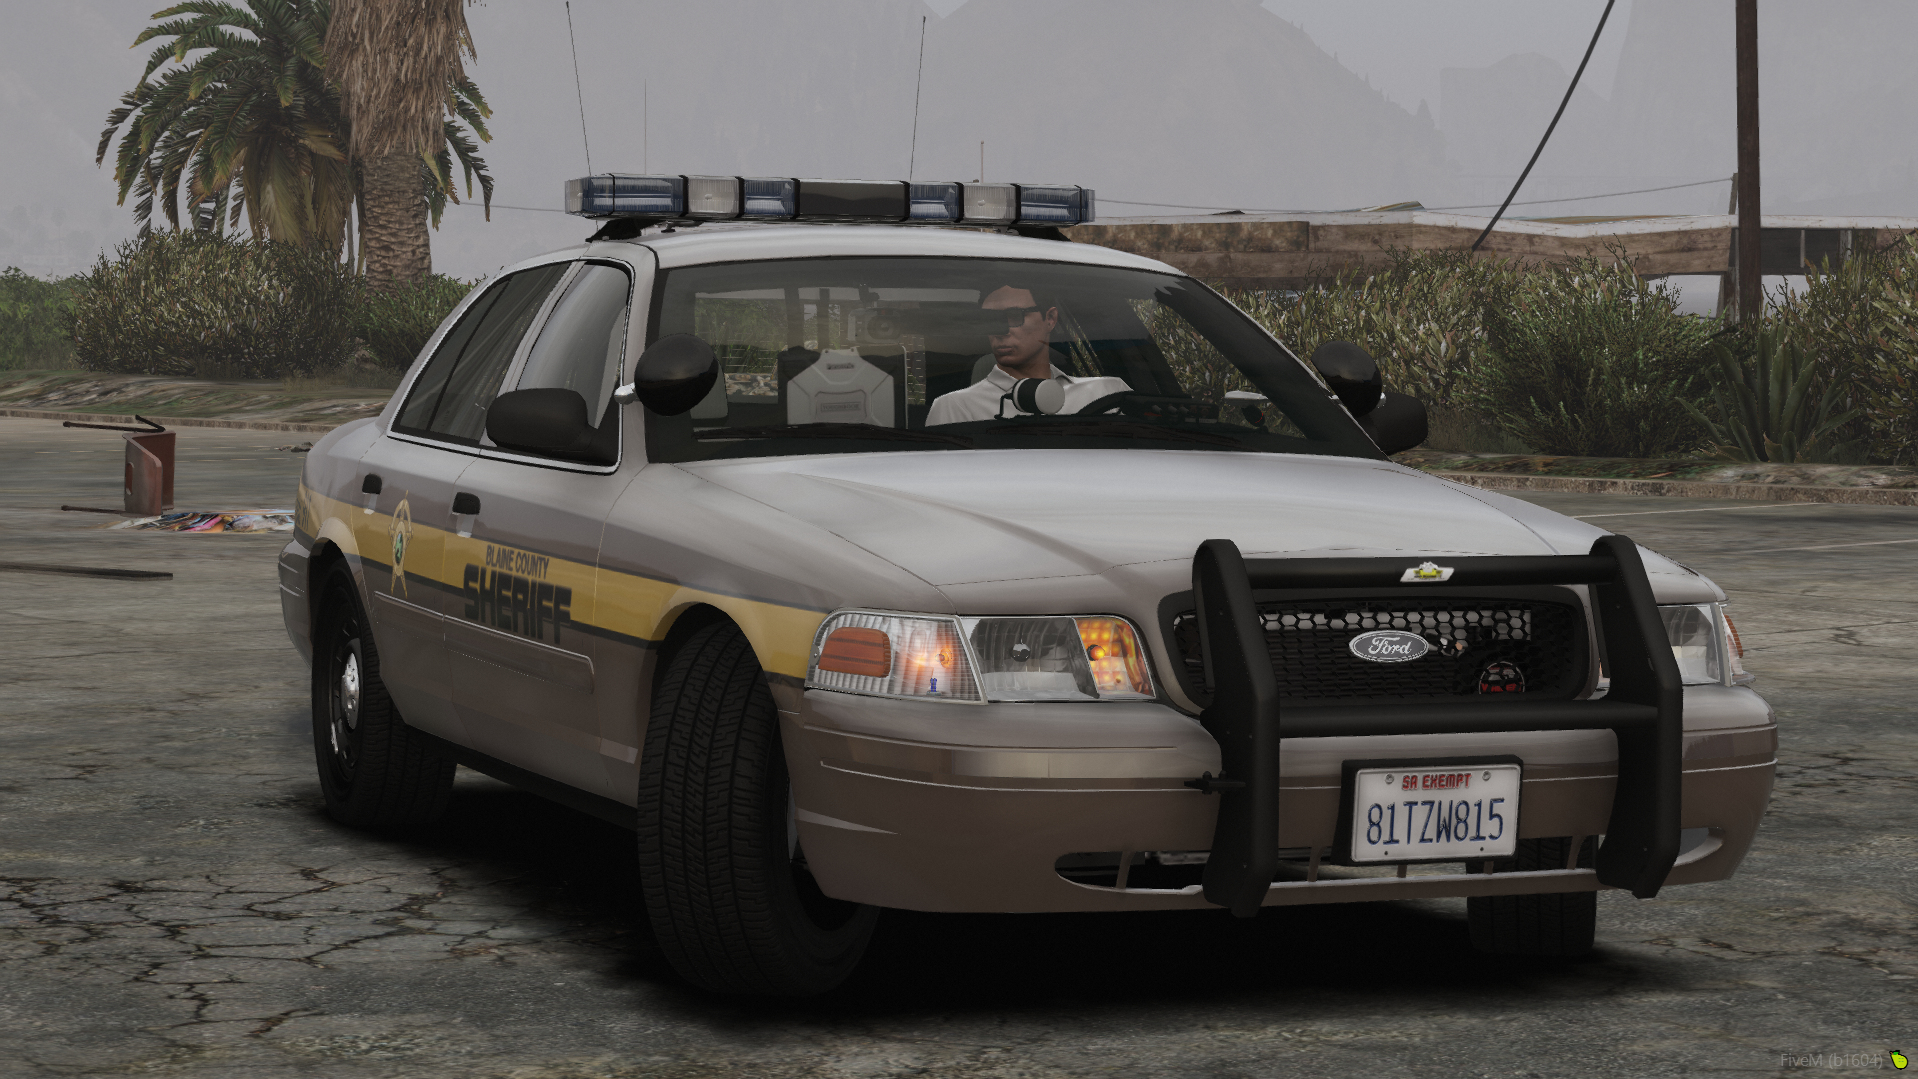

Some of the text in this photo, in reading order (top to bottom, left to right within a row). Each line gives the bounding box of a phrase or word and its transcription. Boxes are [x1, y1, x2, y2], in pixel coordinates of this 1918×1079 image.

[486, 544, 550, 580] BLAINE COUNTY
[464, 563, 572, 645] SHERIFF
[1368, 636, 1412, 655] Ford
[1402, 773, 1471, 790] SA EXEMPT
[1366, 797, 1505, 846] 81TZW815
